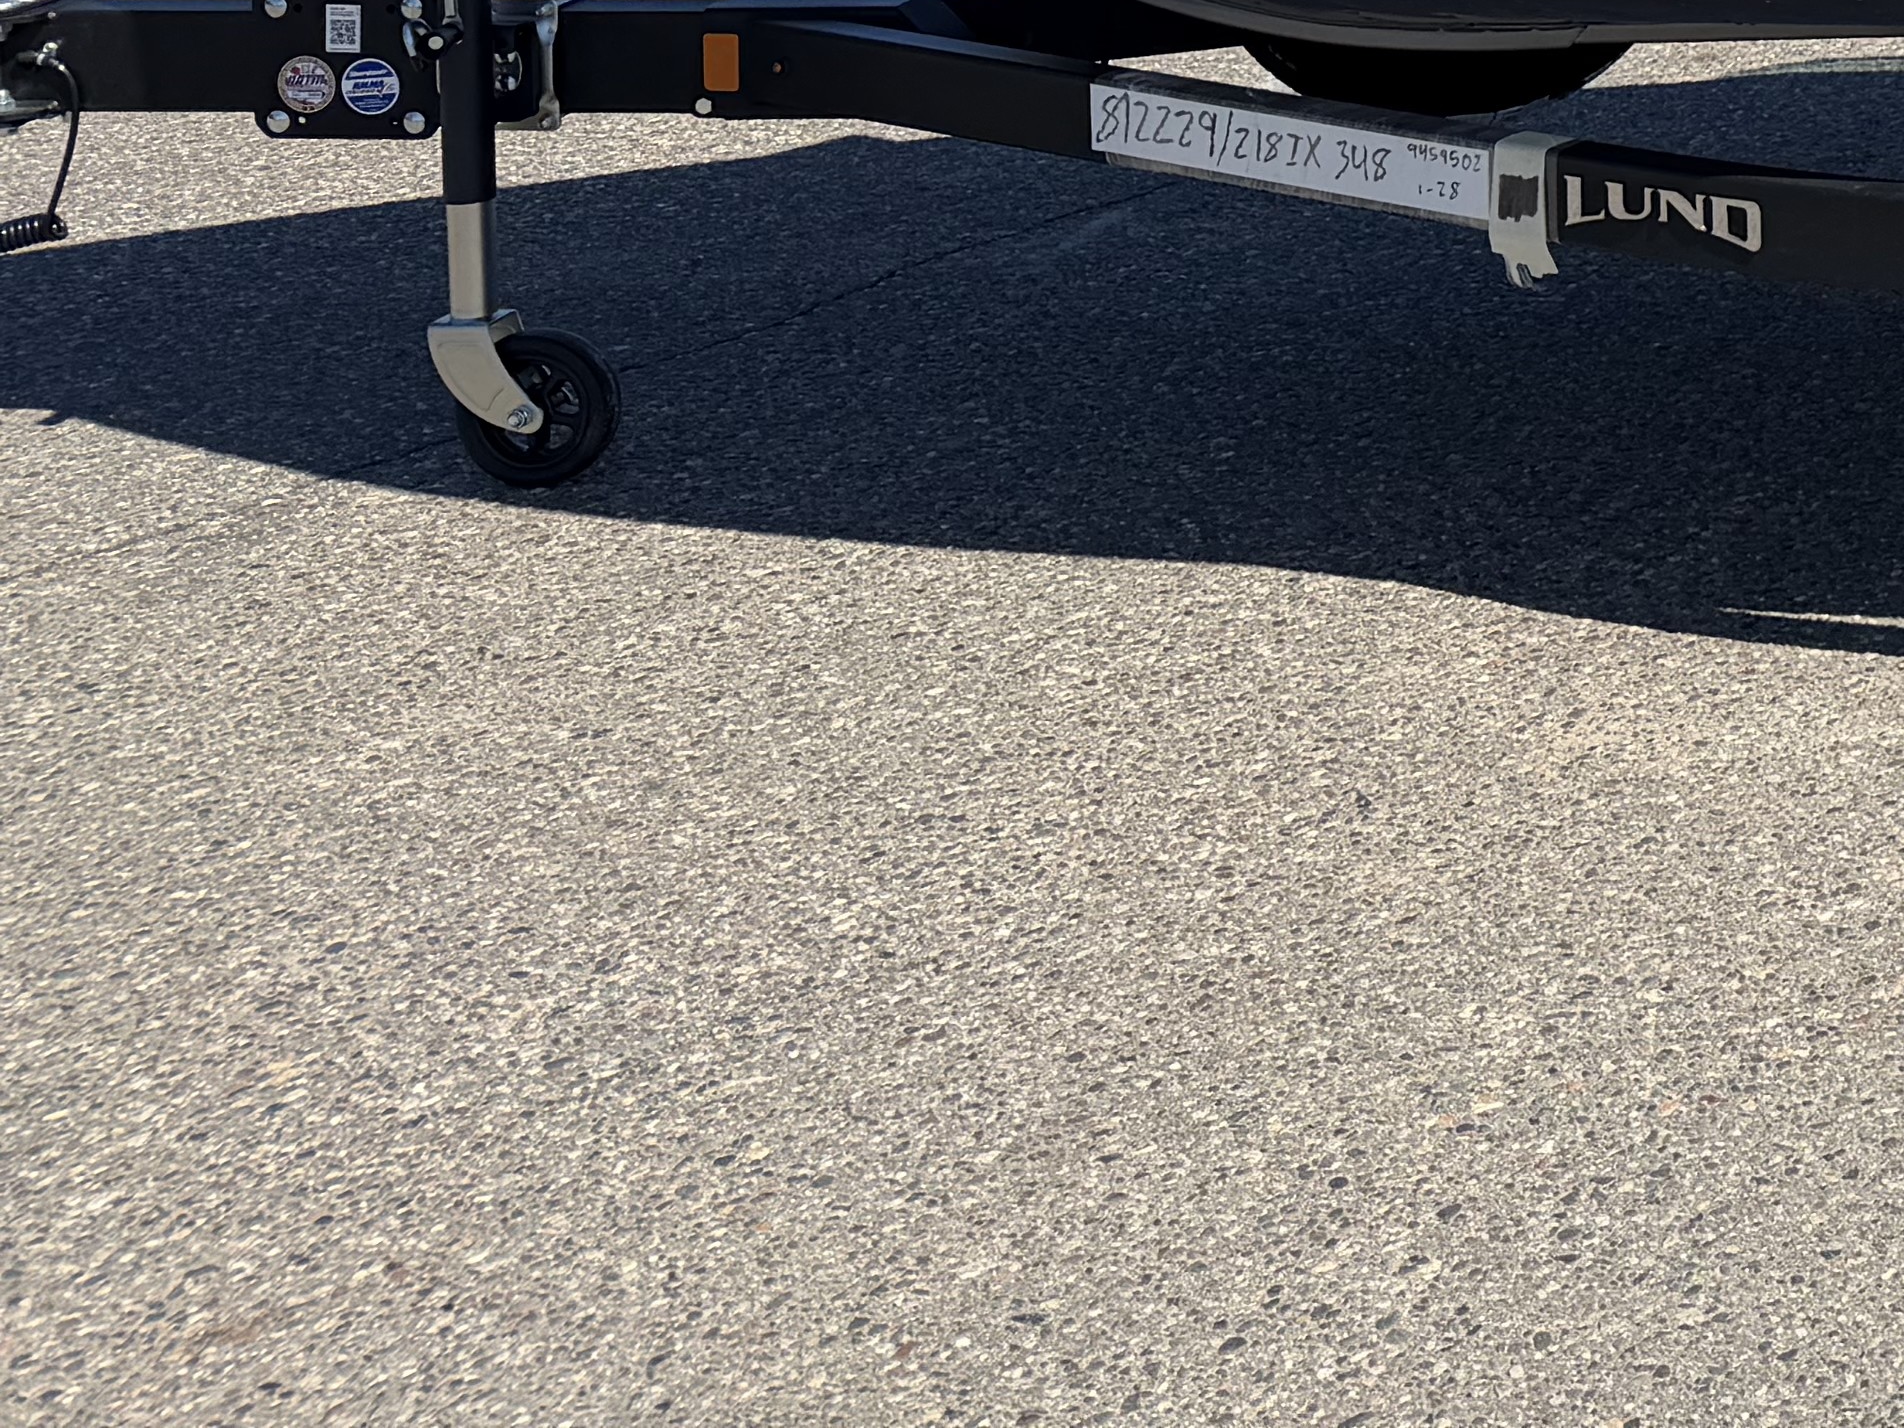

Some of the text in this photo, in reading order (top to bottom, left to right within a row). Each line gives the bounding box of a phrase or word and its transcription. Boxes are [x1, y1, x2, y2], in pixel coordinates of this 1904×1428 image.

[1335, 140, 1392, 182] 348
[1418, 180, 1461, 200] 1-28
[1563, 174, 1762, 253] LUND
